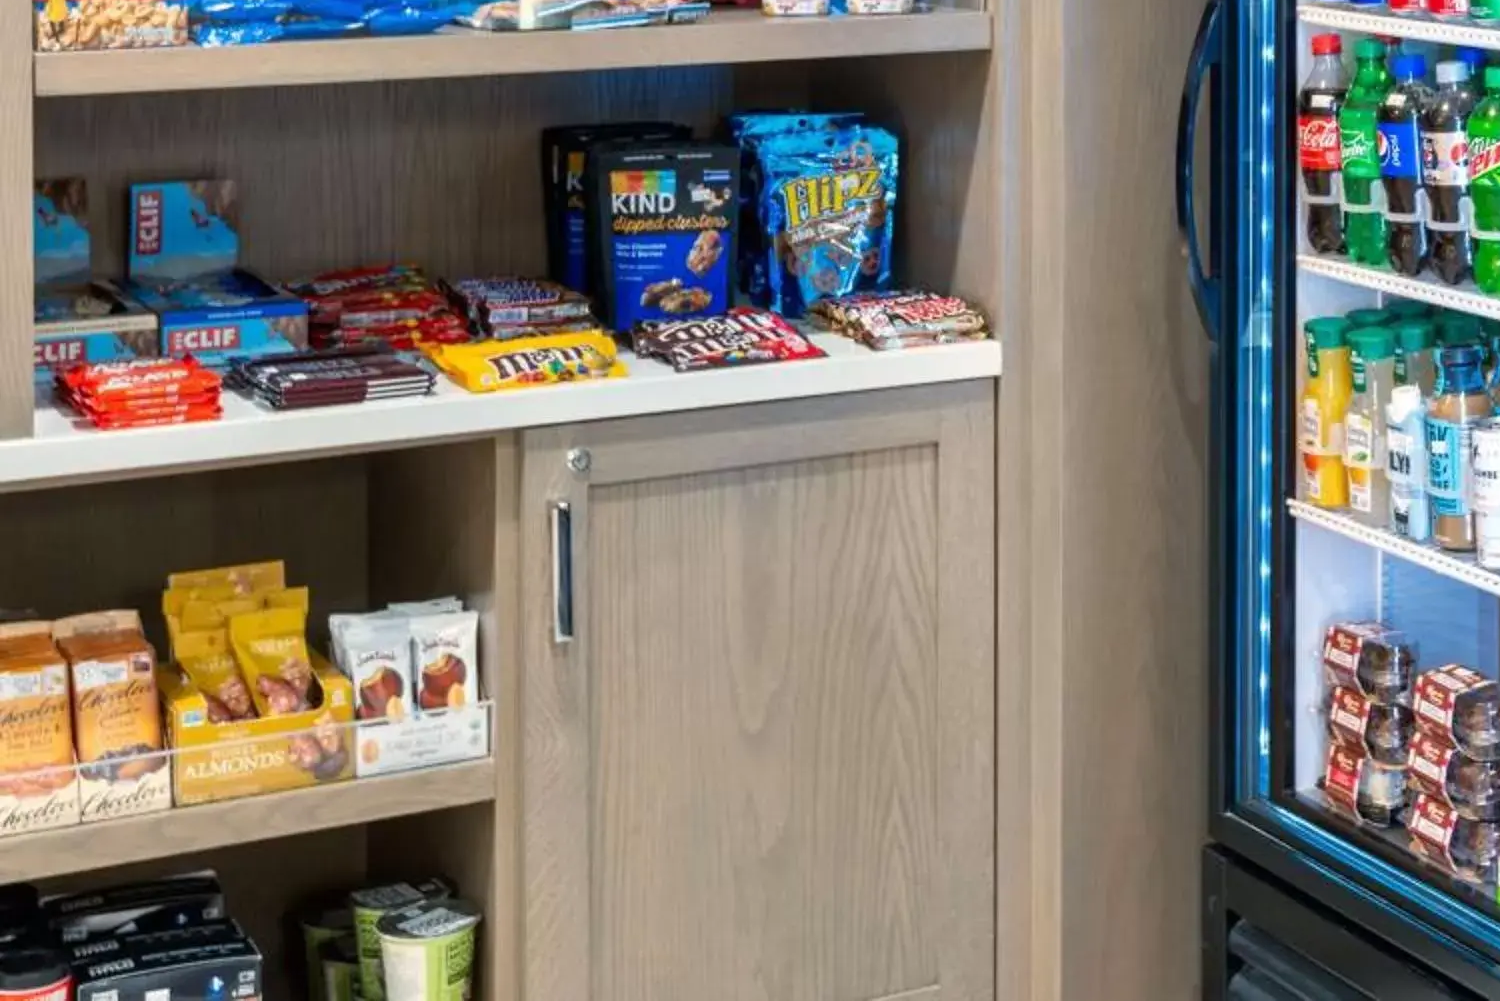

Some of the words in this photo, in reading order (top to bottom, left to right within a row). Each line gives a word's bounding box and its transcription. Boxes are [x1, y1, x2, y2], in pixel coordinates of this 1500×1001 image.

[610, 192, 677, 214] KIND
[785, 169, 880, 228] Flipz
[139, 193, 163, 242] CLIF
[181, 327, 238, 351] CLIF
[185, 749, 287, 779] ALMONDS
